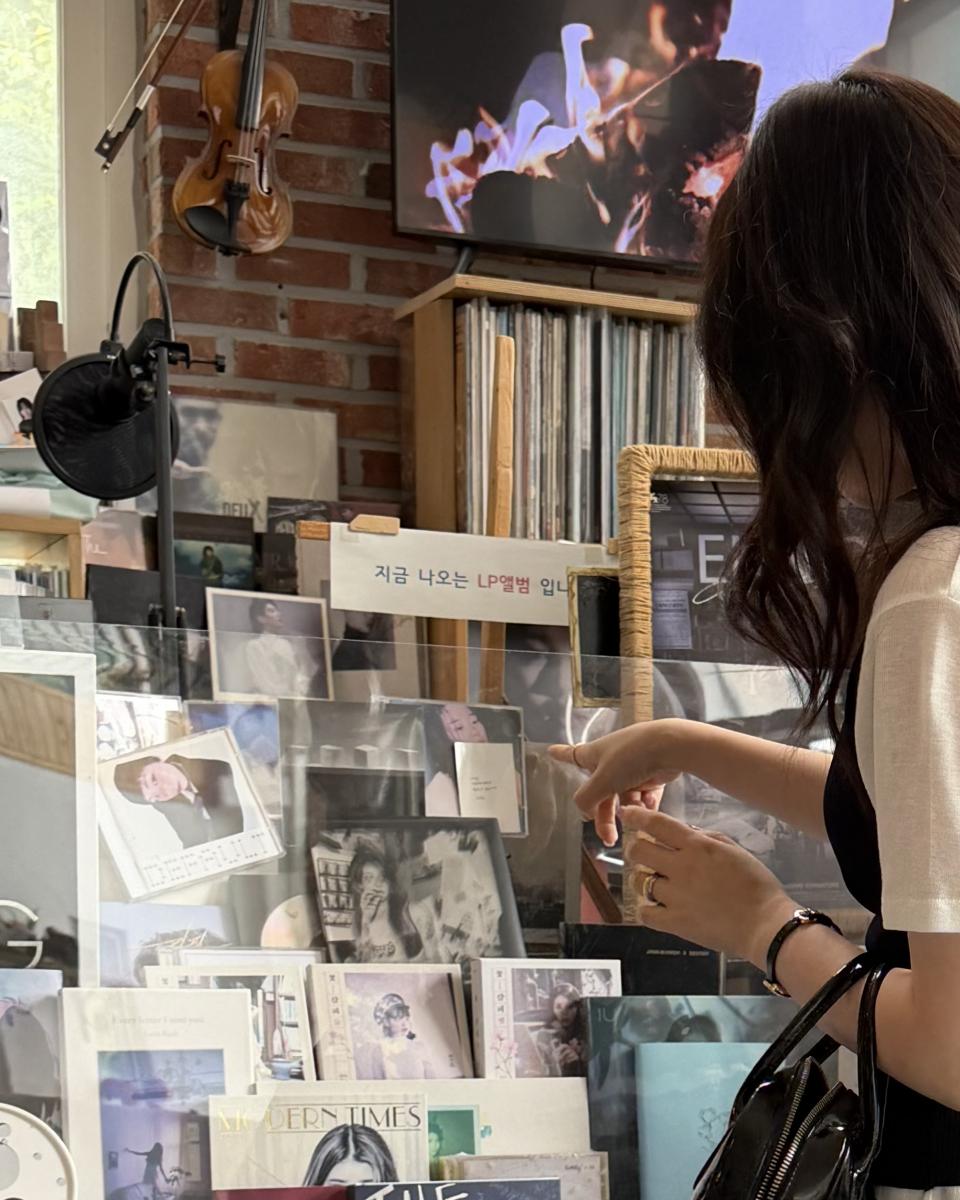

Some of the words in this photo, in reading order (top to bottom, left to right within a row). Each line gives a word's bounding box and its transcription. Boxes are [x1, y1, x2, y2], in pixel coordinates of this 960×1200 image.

[375, 565, 409, 585] 지금
[418, 568, 469, 589] 나오는
[477, 573, 531, 594] LP앨범
[347, 1104, 421, 1129] TIMES
